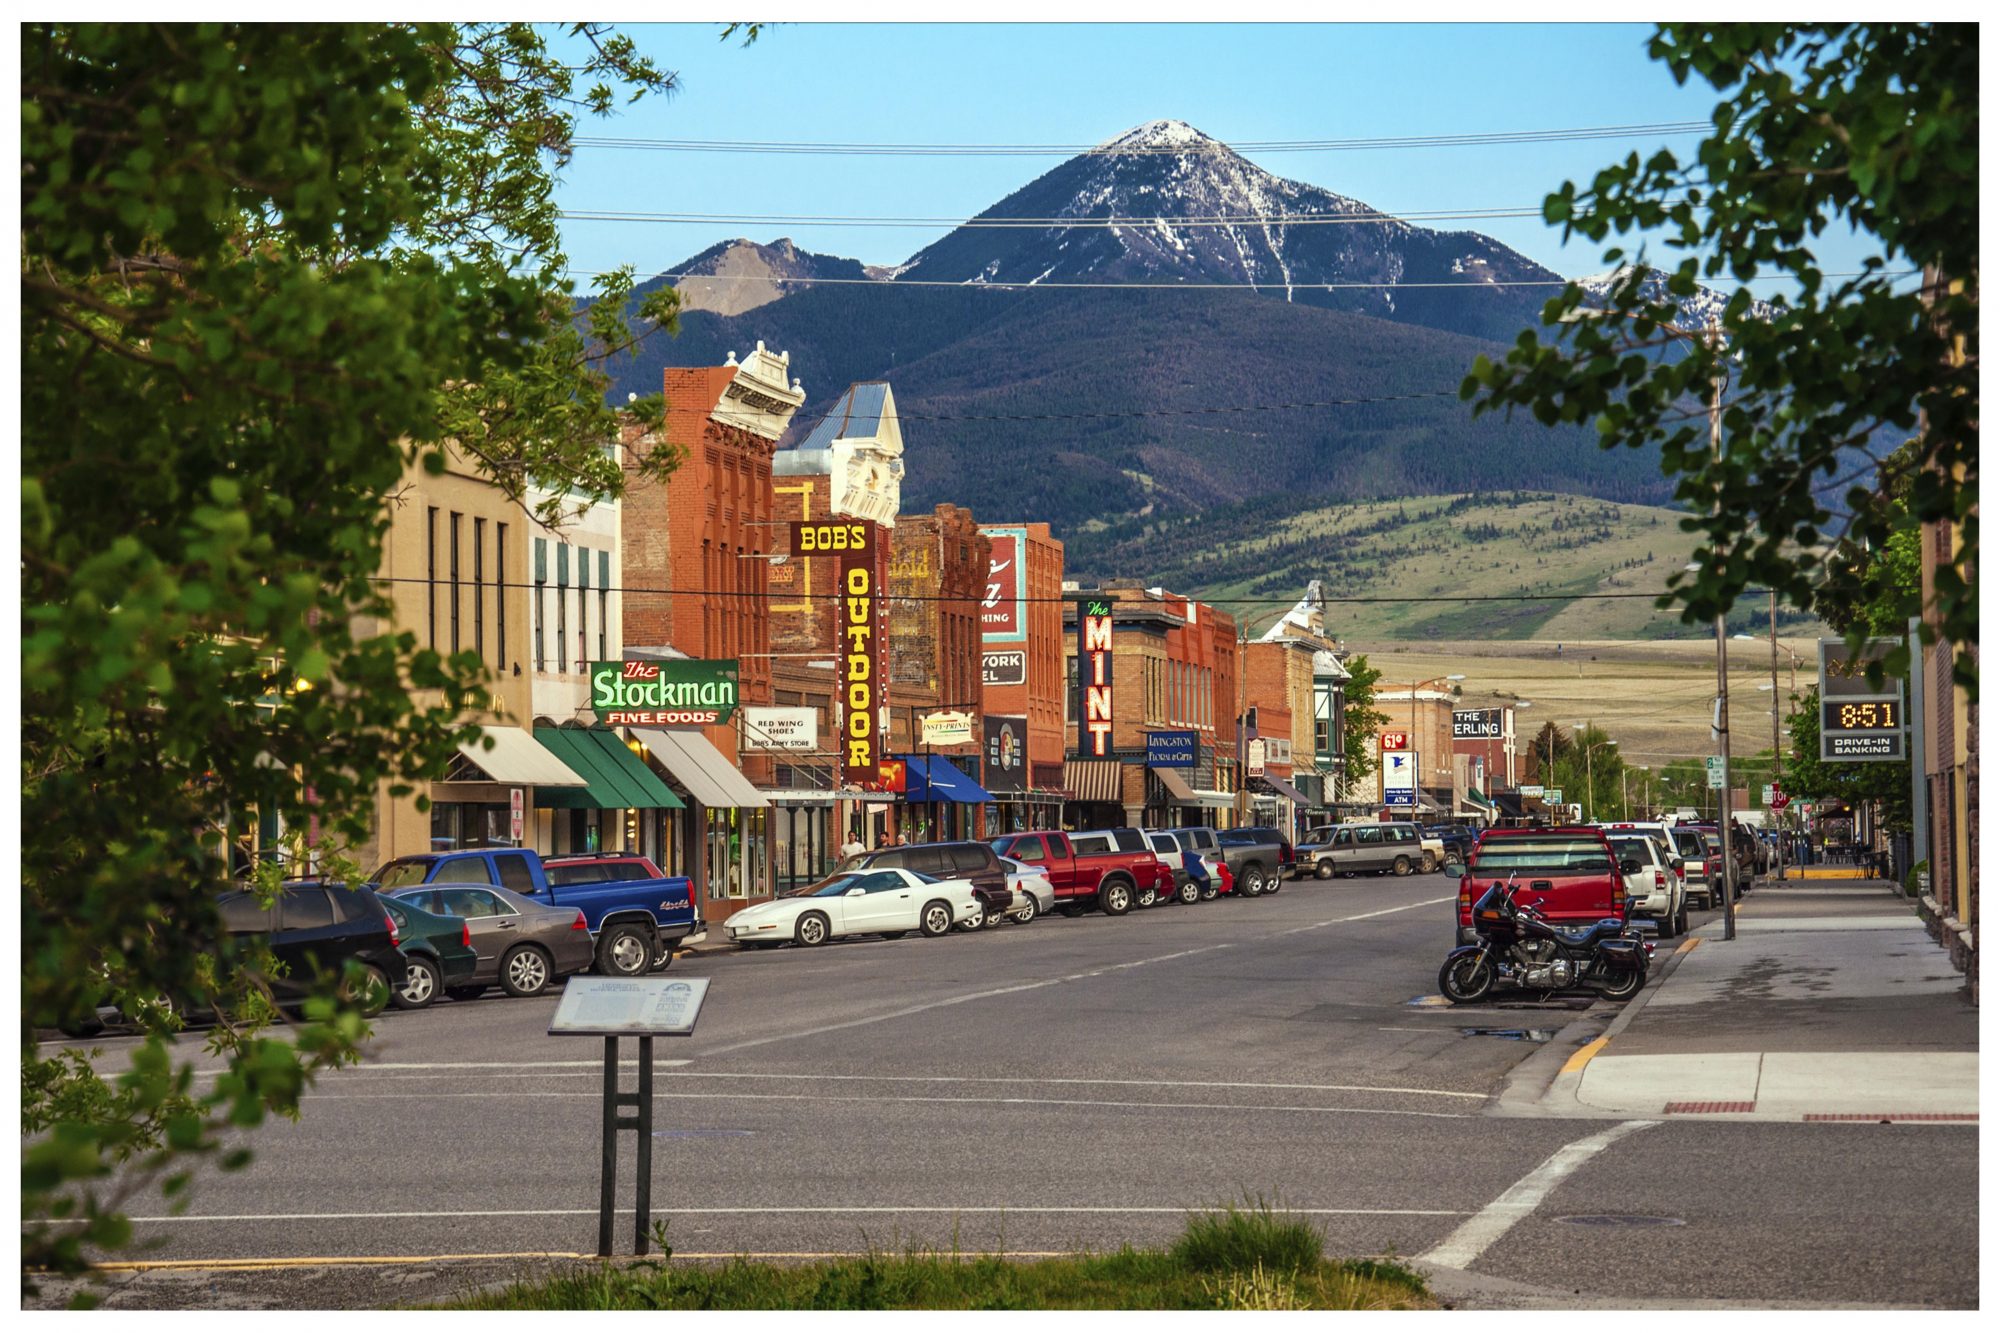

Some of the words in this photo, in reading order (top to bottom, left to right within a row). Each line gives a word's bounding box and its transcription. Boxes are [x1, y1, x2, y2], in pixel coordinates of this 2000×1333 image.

[800, 524, 866, 550] BOB'S
[1087, 601, 1109, 616] The
[981, 613, 1010, 623] HING
[847, 568, 871, 767] OUTDOOR
[982, 655, 1020, 668] YORK
[623, 661, 659, 679] The
[982, 670, 999, 681] EL
[593, 668, 735, 707] Stockman
[1085, 616, 1113, 756] MINT
[605, 712, 655, 724] FINE
[656, 711, 719, 724] FOODS
[1455, 712, 1480, 721] THE
[1841, 703, 1895, 728] 8:51
[1452, 723, 1499, 735] ERLING
[1834, 738, 1890, 746] DRIVE-IN
[1834, 746, 1891, 754] BANKING
